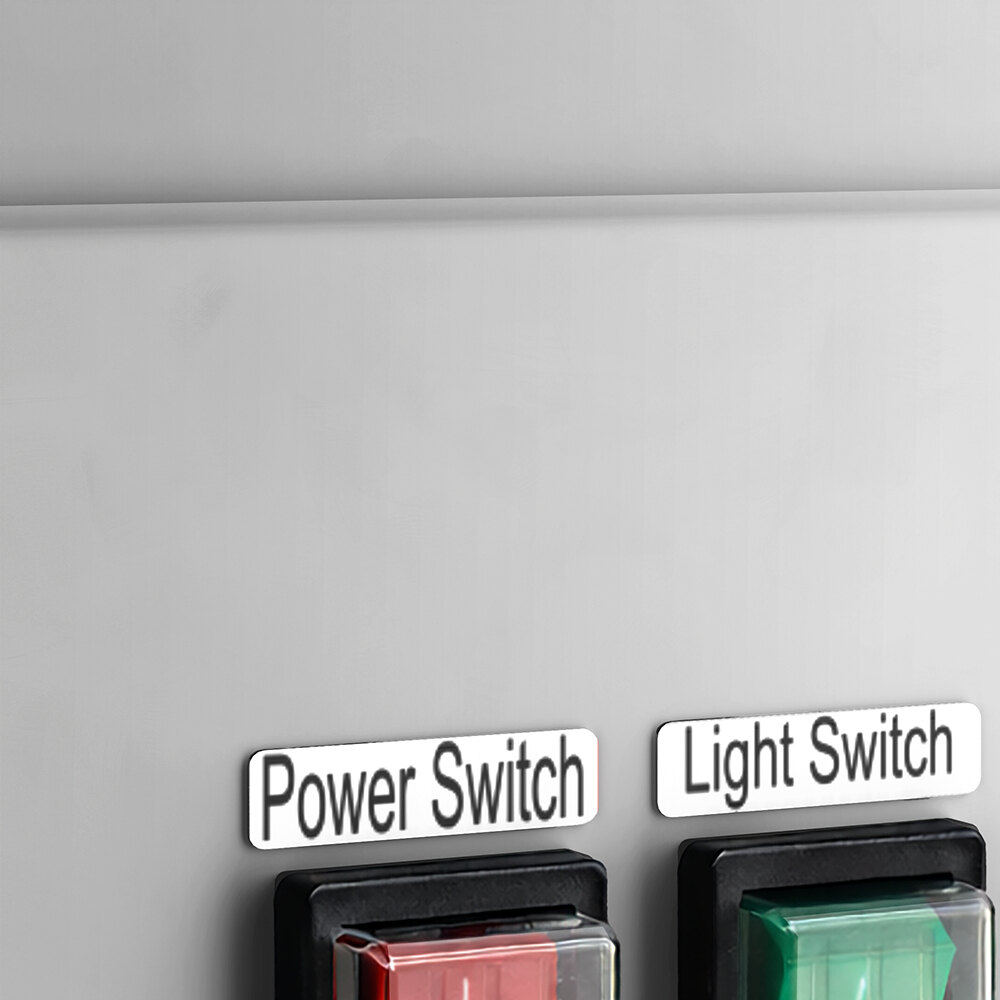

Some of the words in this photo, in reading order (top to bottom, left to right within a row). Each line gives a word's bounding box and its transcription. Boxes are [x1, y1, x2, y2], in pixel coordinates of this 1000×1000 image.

[261, 752, 417, 842] Power
[431, 735, 586, 828] Switch
[682, 724, 793, 811] Light
[807, 709, 954, 783] Switch
